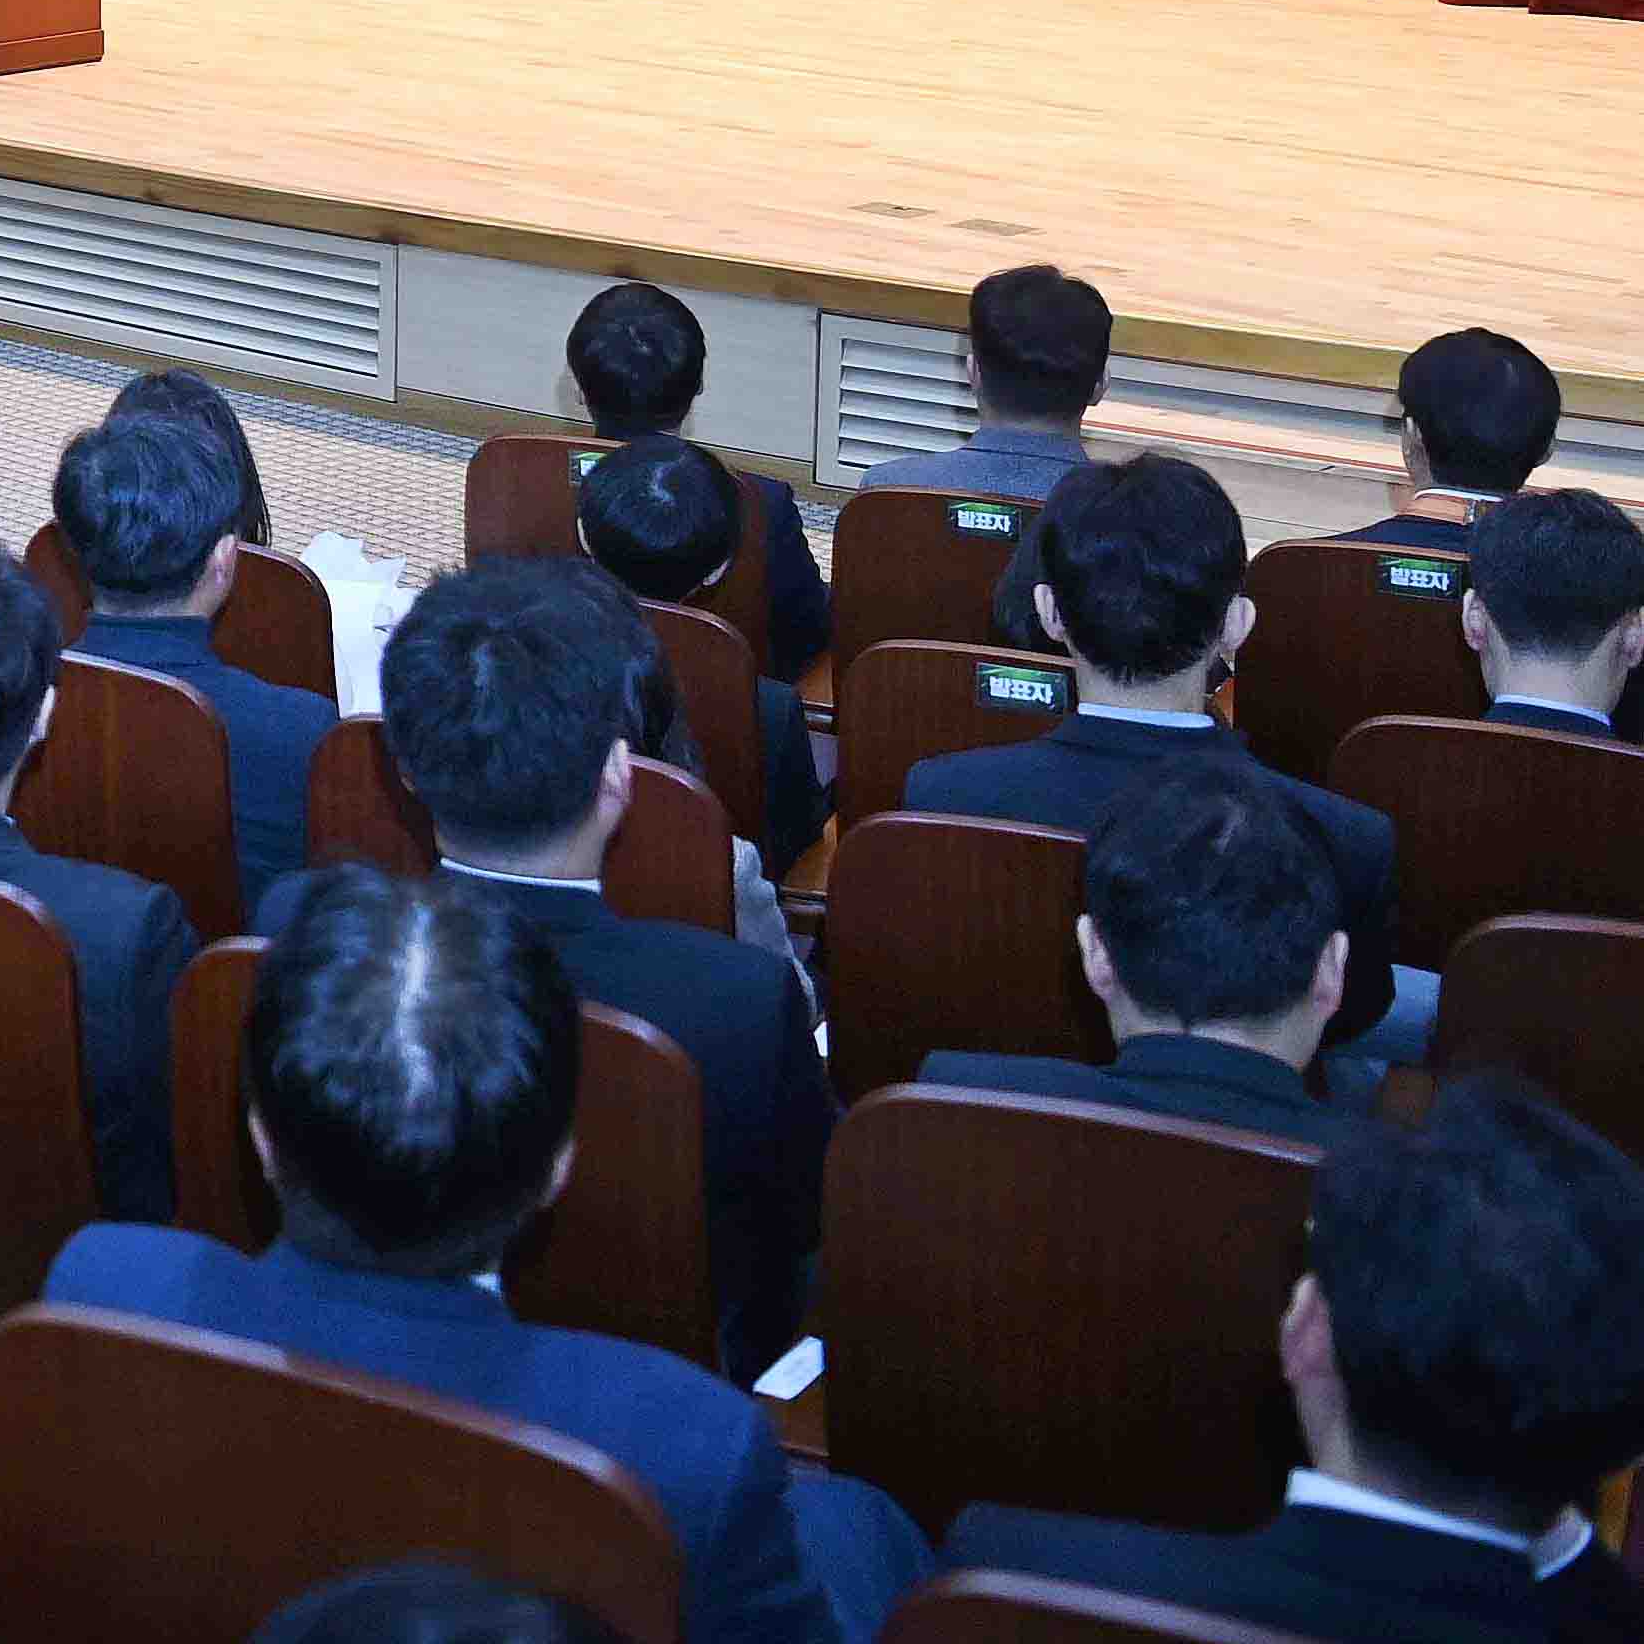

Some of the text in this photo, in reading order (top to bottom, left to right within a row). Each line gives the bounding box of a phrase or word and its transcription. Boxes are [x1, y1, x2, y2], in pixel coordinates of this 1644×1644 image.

[957, 509, 1011, 533] 발표자
[1390, 566, 1448, 591] 발표자
[989, 675, 1053, 705] 발표자
